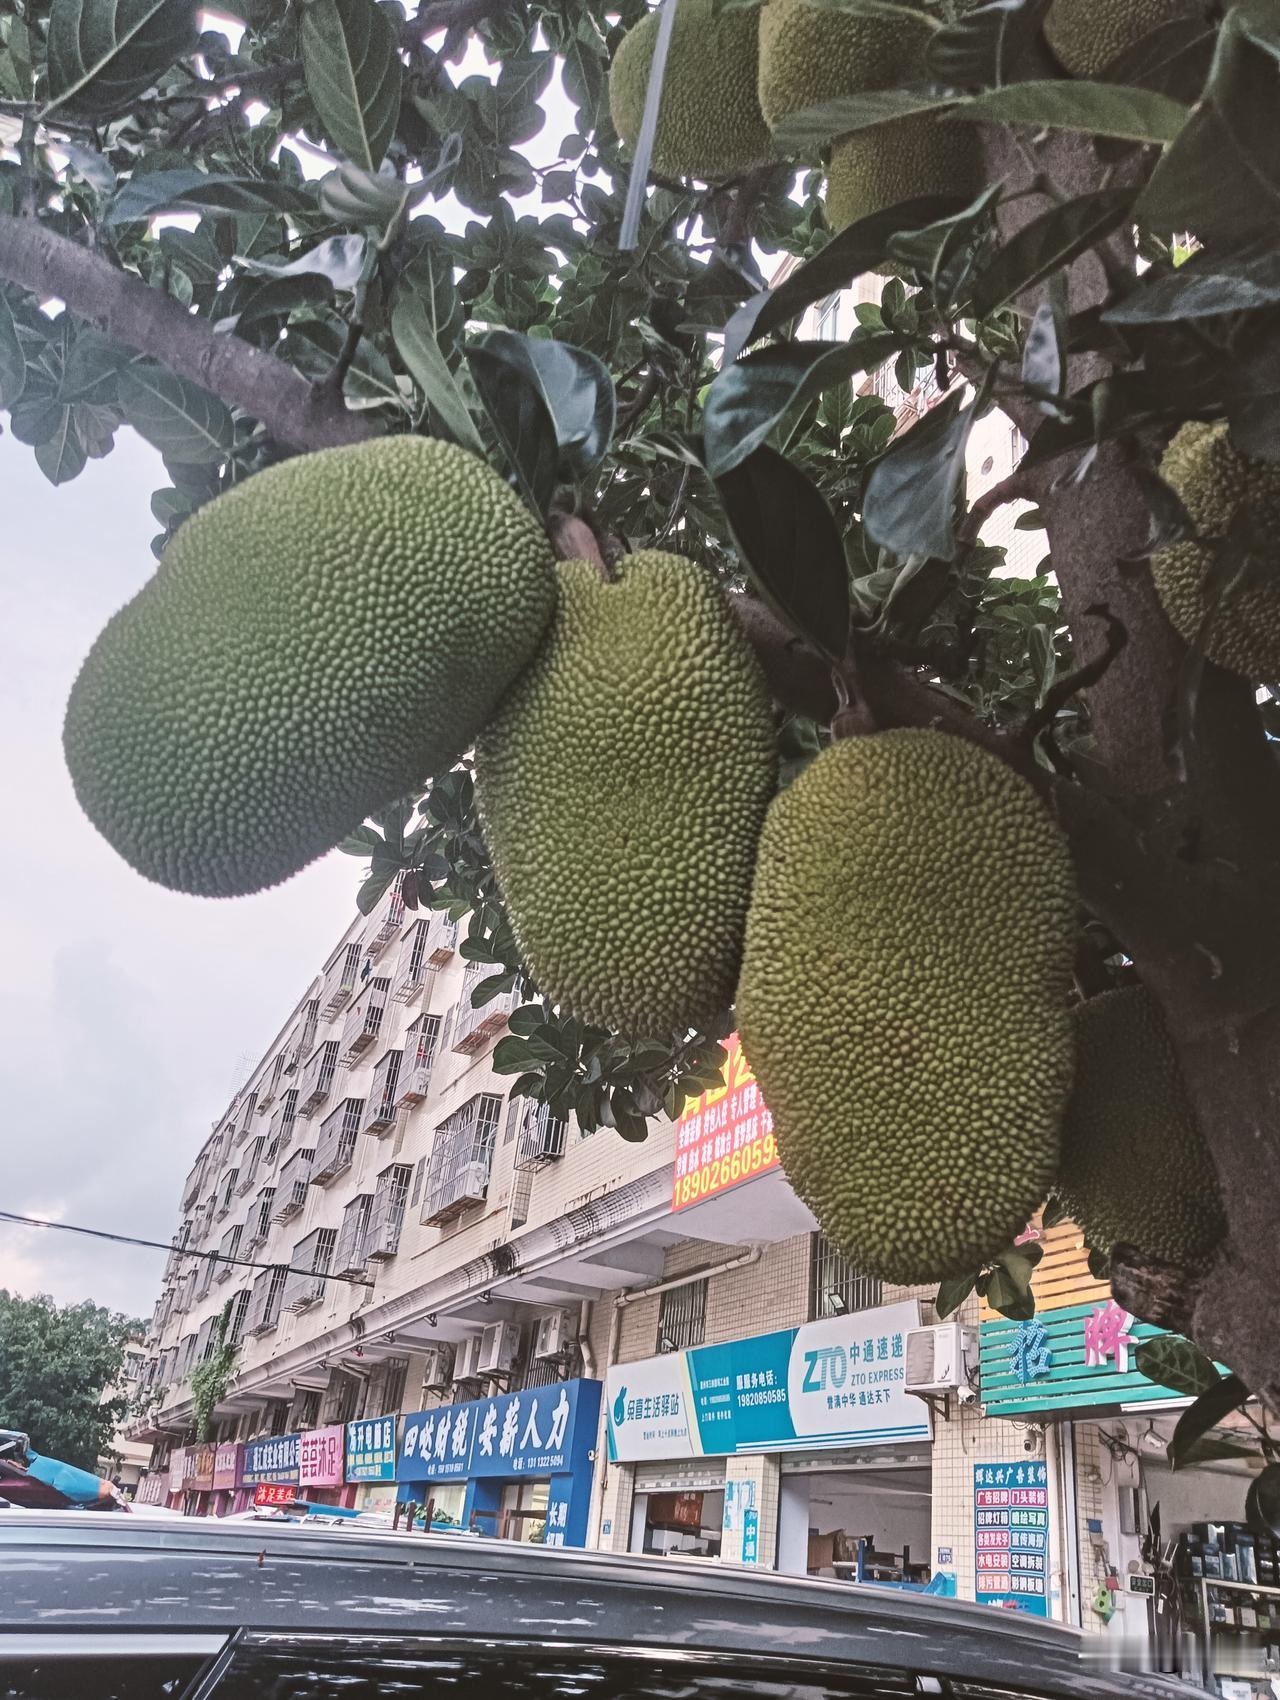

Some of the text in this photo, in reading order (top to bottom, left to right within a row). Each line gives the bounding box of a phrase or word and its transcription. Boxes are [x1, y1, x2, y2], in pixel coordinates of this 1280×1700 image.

[850, 1332, 903, 1365] 中通速递
[802, 1345, 847, 1393] ZTO
[851, 1367, 904, 1386] ZTO EXPRESS
[737, 1389, 787, 1408] 19820850585
[859, 1389, 891, 1406] 通达天下
[627, 1394, 680, 1421] 兔喜生活驿站
[478, 1388, 570, 1458] 安薪人力
[977, 1491, 1046, 1505] 广告招牌 门头装修
[549, 1501, 568, 1528] 长期
[977, 1511, 1045, 1526] 招牌灯箱 喷绘写真
[977, 1533, 1044, 1549] 各类发光字 宣传海报
[977, 1554, 1043, 1570] 水电安装 空调拆装
